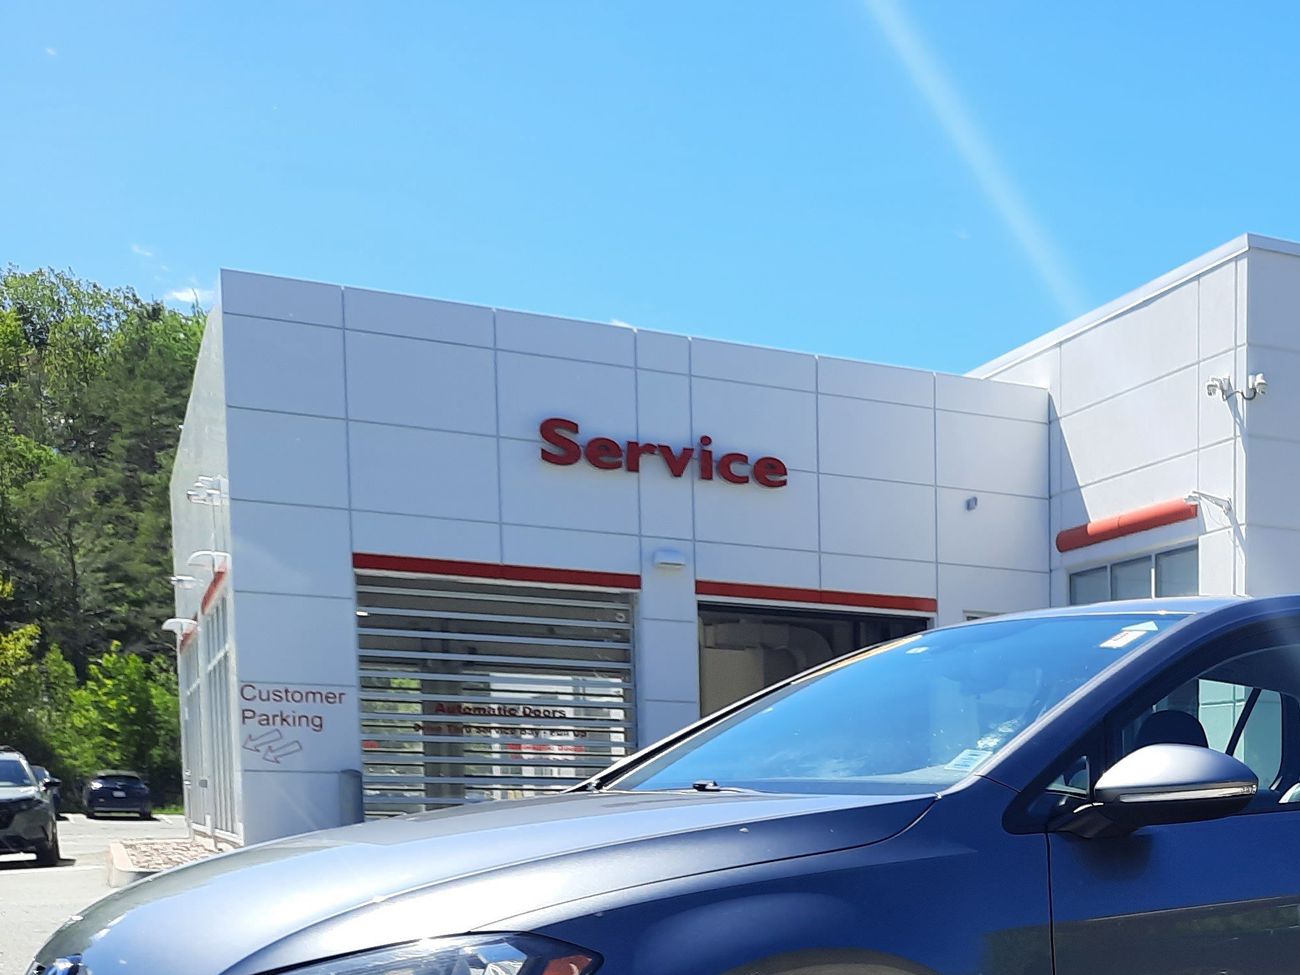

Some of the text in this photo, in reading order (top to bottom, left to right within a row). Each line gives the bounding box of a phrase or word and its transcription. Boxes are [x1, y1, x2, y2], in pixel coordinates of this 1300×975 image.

[539, 417, 788, 488] Service
[240, 684, 346, 705] Customer
[241, 708, 324, 732] Parking
